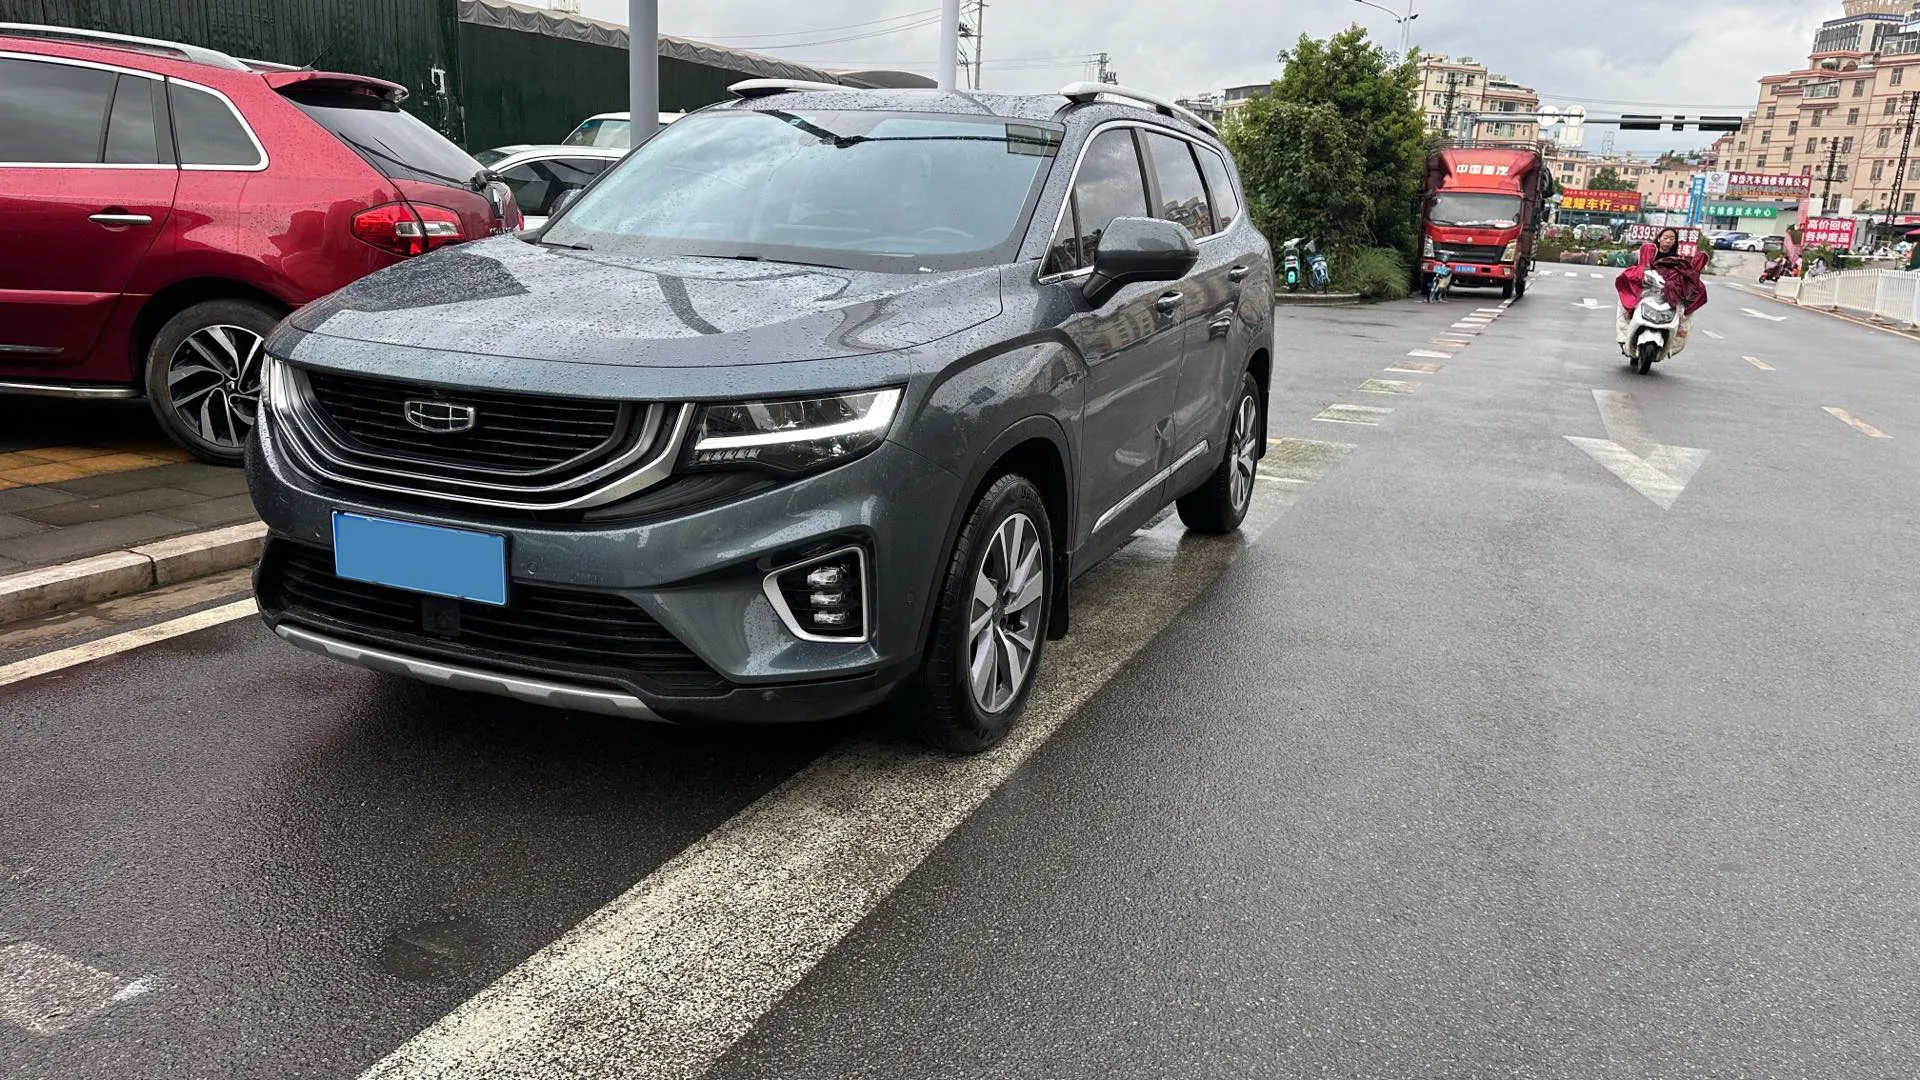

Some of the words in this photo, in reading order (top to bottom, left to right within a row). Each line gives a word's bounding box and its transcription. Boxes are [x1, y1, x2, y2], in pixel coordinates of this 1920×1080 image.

[1456, 164, 1509, 175] 中国重汽
[1561, 196, 1612, 211] 星耀车行
[1807, 219, 1852, 231] 高价回收
[1805, 231, 1850, 243] 各种废品
